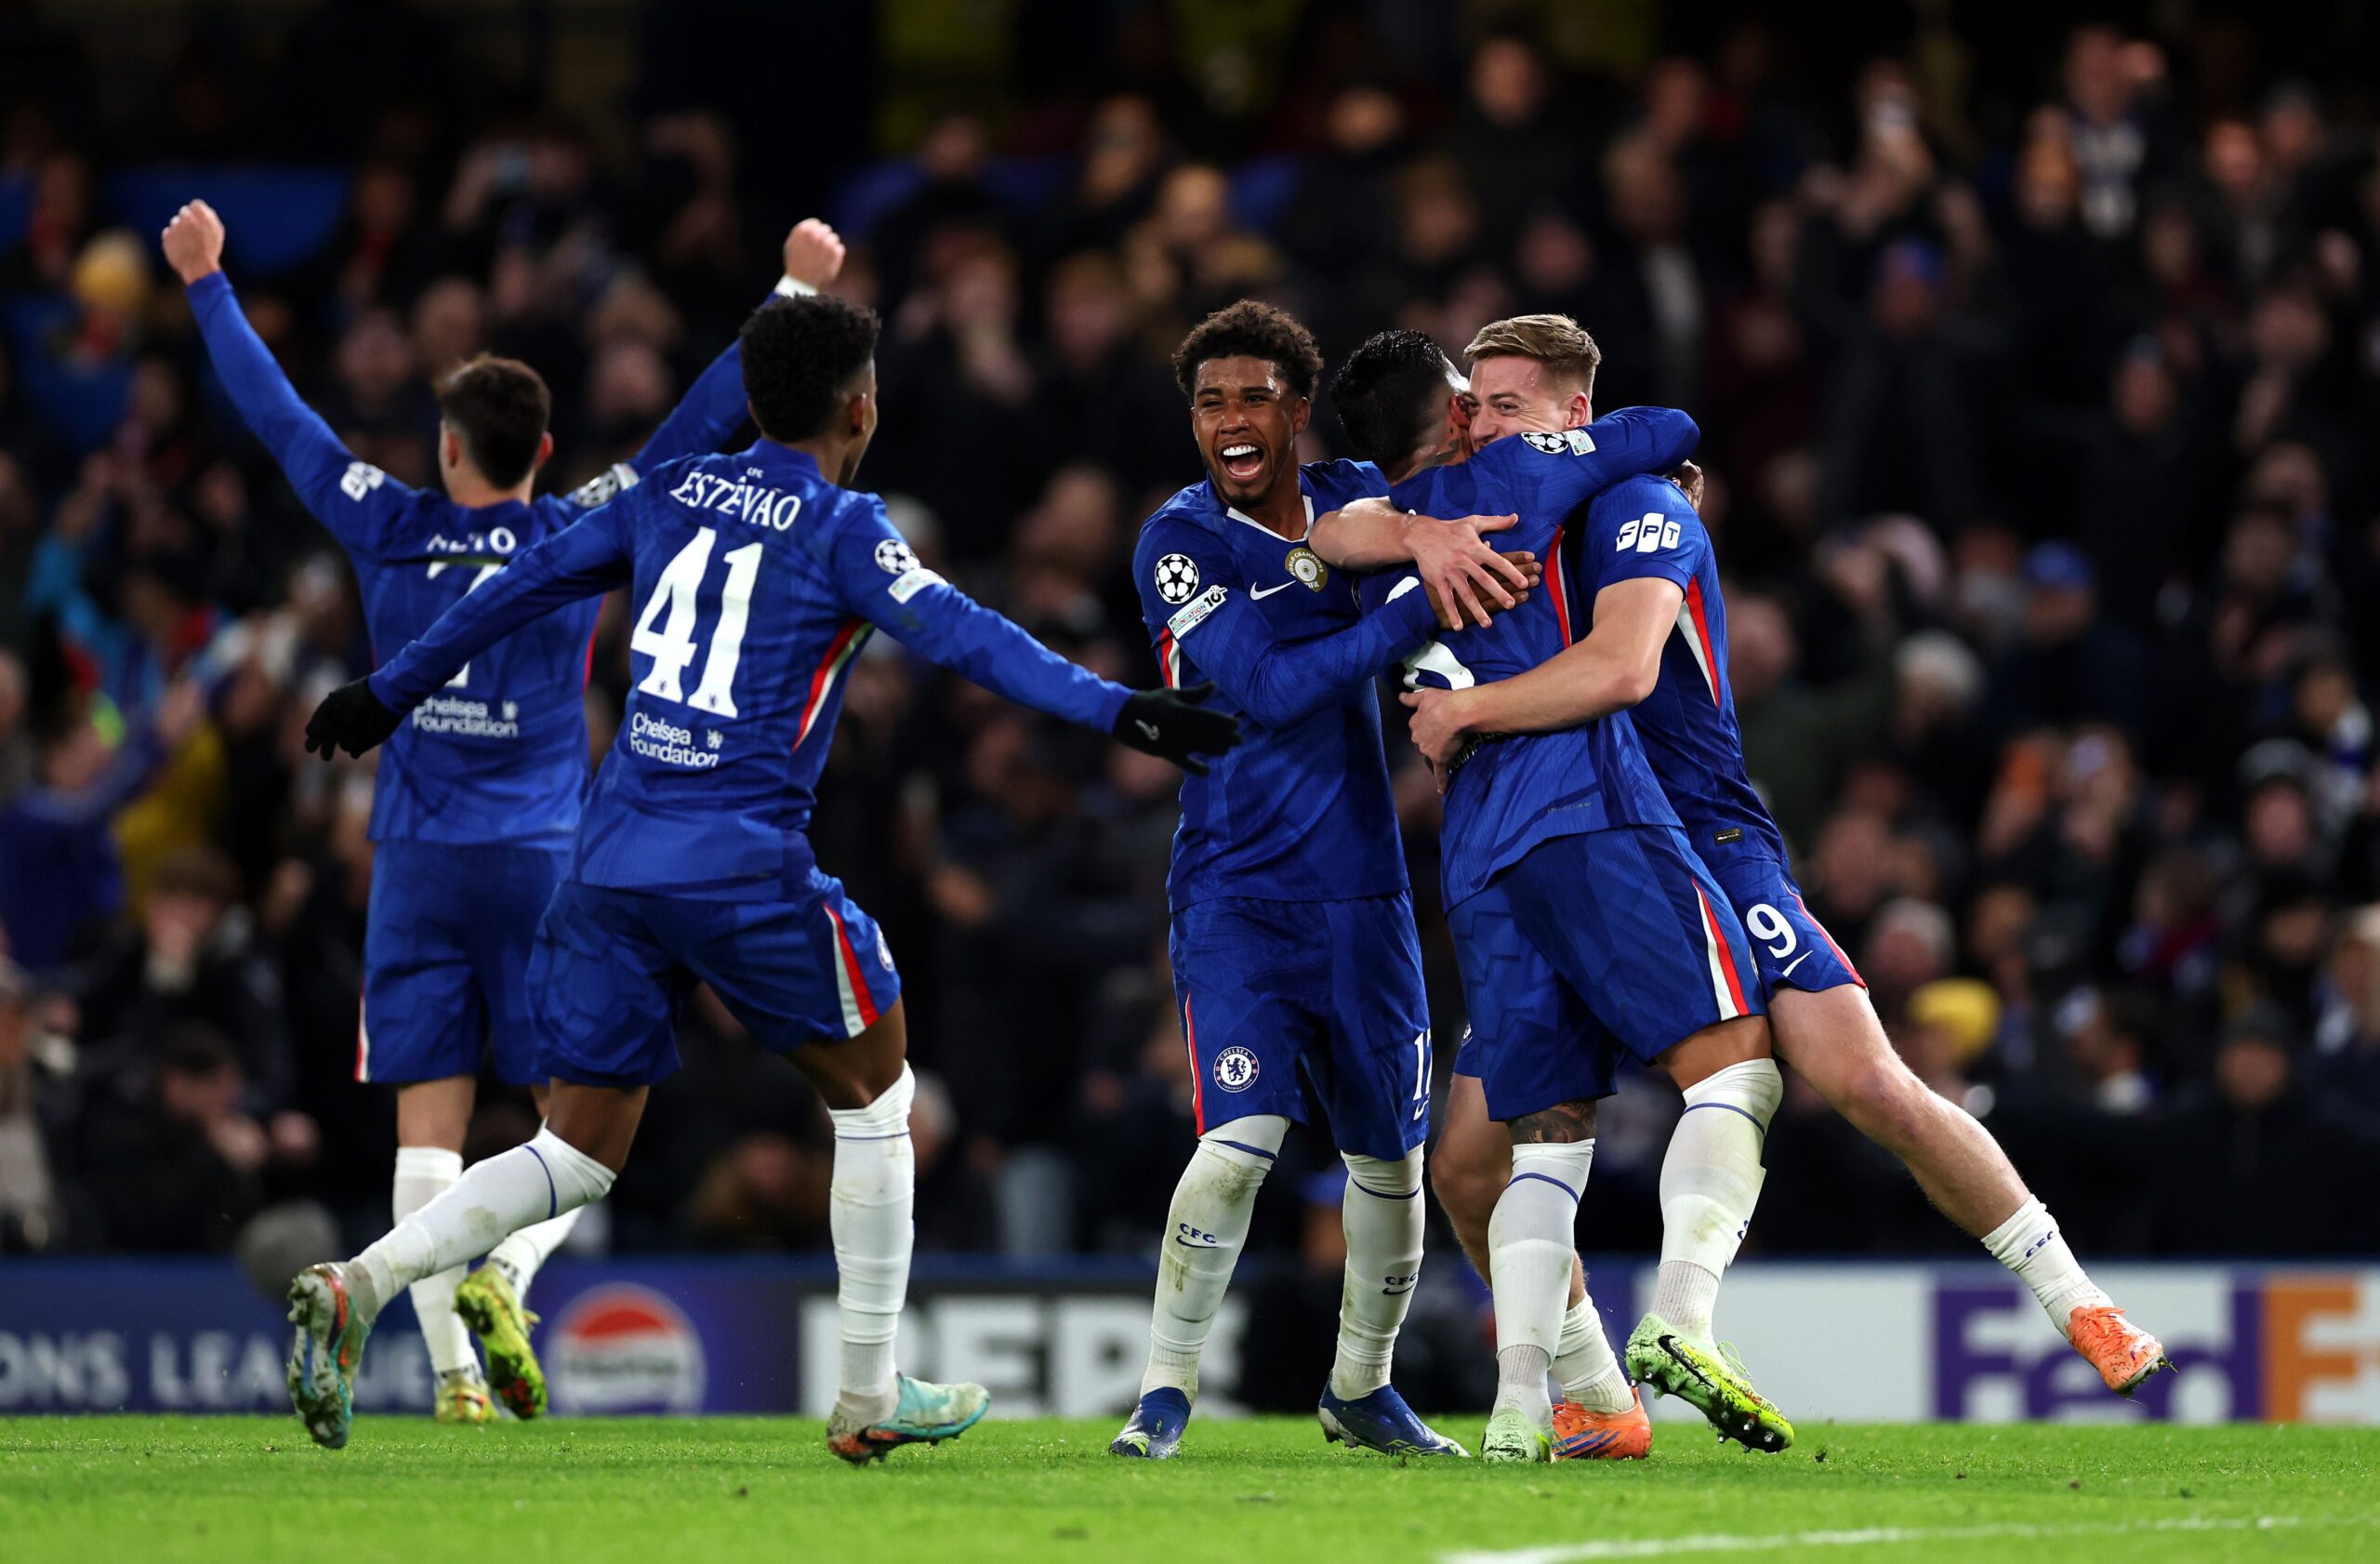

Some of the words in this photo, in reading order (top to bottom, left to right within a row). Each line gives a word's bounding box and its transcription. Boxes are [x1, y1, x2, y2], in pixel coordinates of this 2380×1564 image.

[1618, 521, 1680, 547] FPT
[1294, 551, 1324, 573] CHAMPIONS
[630, 526, 763, 719] 41
[631, 712, 692, 747] Chelsea
[629, 732, 720, 768] Foundation
[1747, 903, 1797, 959] 9
[1219, 1048, 1249, 1061] CHELSEA
[1179, 1222, 1217, 1244] CFC
[1384, 1272, 1418, 1285] CFC
